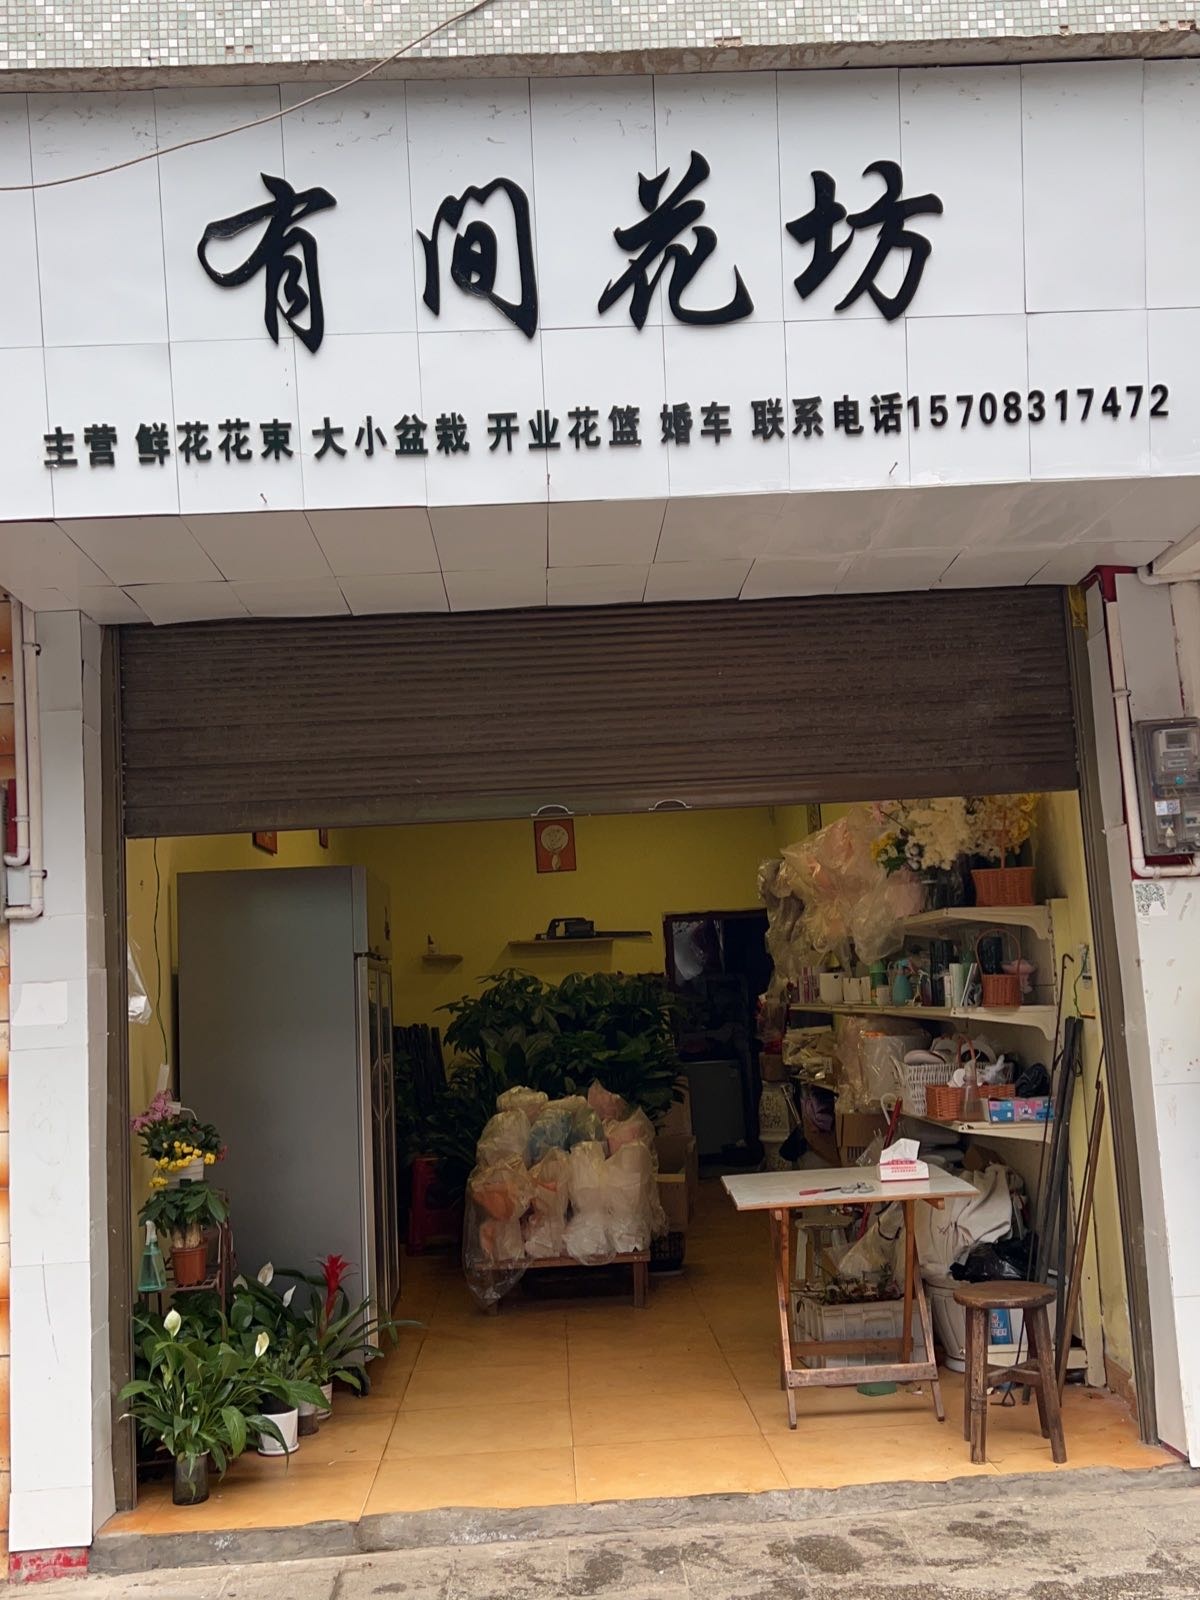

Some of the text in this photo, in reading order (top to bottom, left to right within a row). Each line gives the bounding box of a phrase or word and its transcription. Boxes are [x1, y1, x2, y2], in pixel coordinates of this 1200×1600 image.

[43, 423, 118, 467] 主营
[135, 418, 294, 466] 鲜花花束
[311, 412, 470, 460] 大小盆栽
[487, 405, 642, 451] 开业花篮
[659, 401, 732, 445] 婚车
